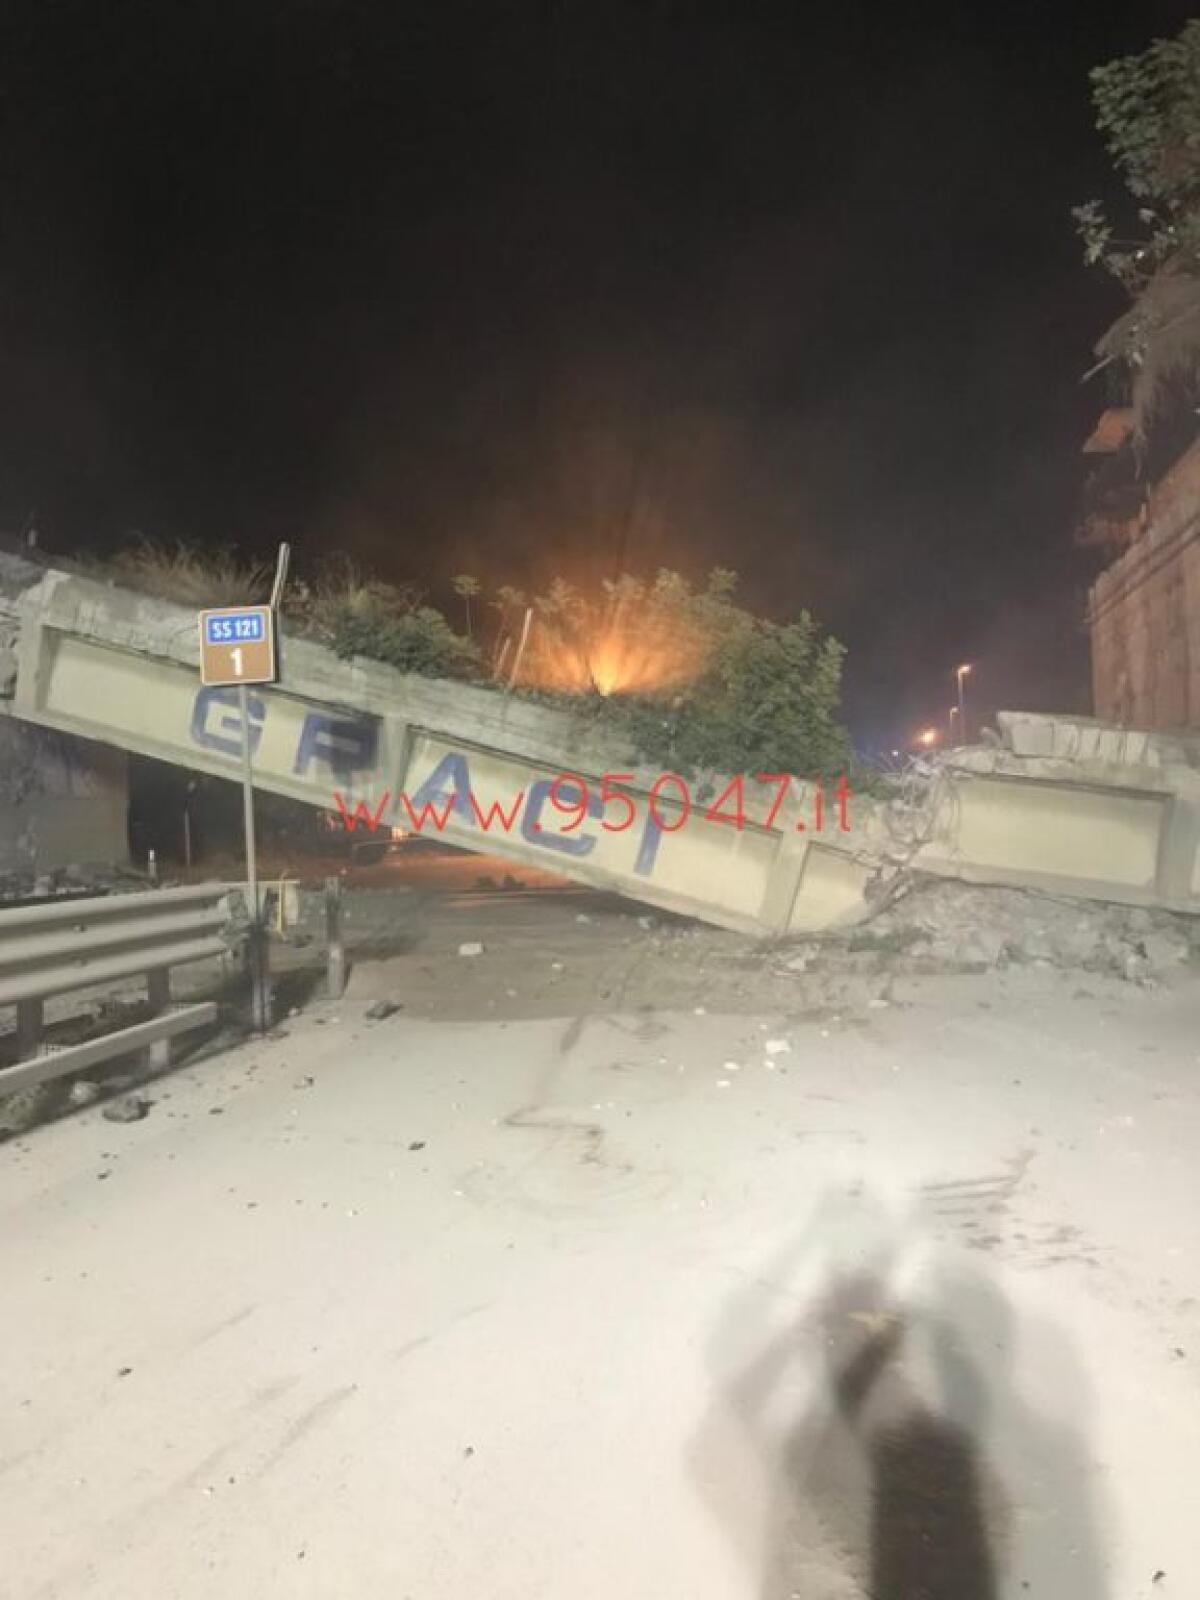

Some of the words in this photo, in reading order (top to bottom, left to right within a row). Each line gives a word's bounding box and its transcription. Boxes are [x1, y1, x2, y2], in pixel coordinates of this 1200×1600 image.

[212, 621, 232, 639] SS
[235, 618, 258, 637] 121
[230, 647, 242, 676] 1
